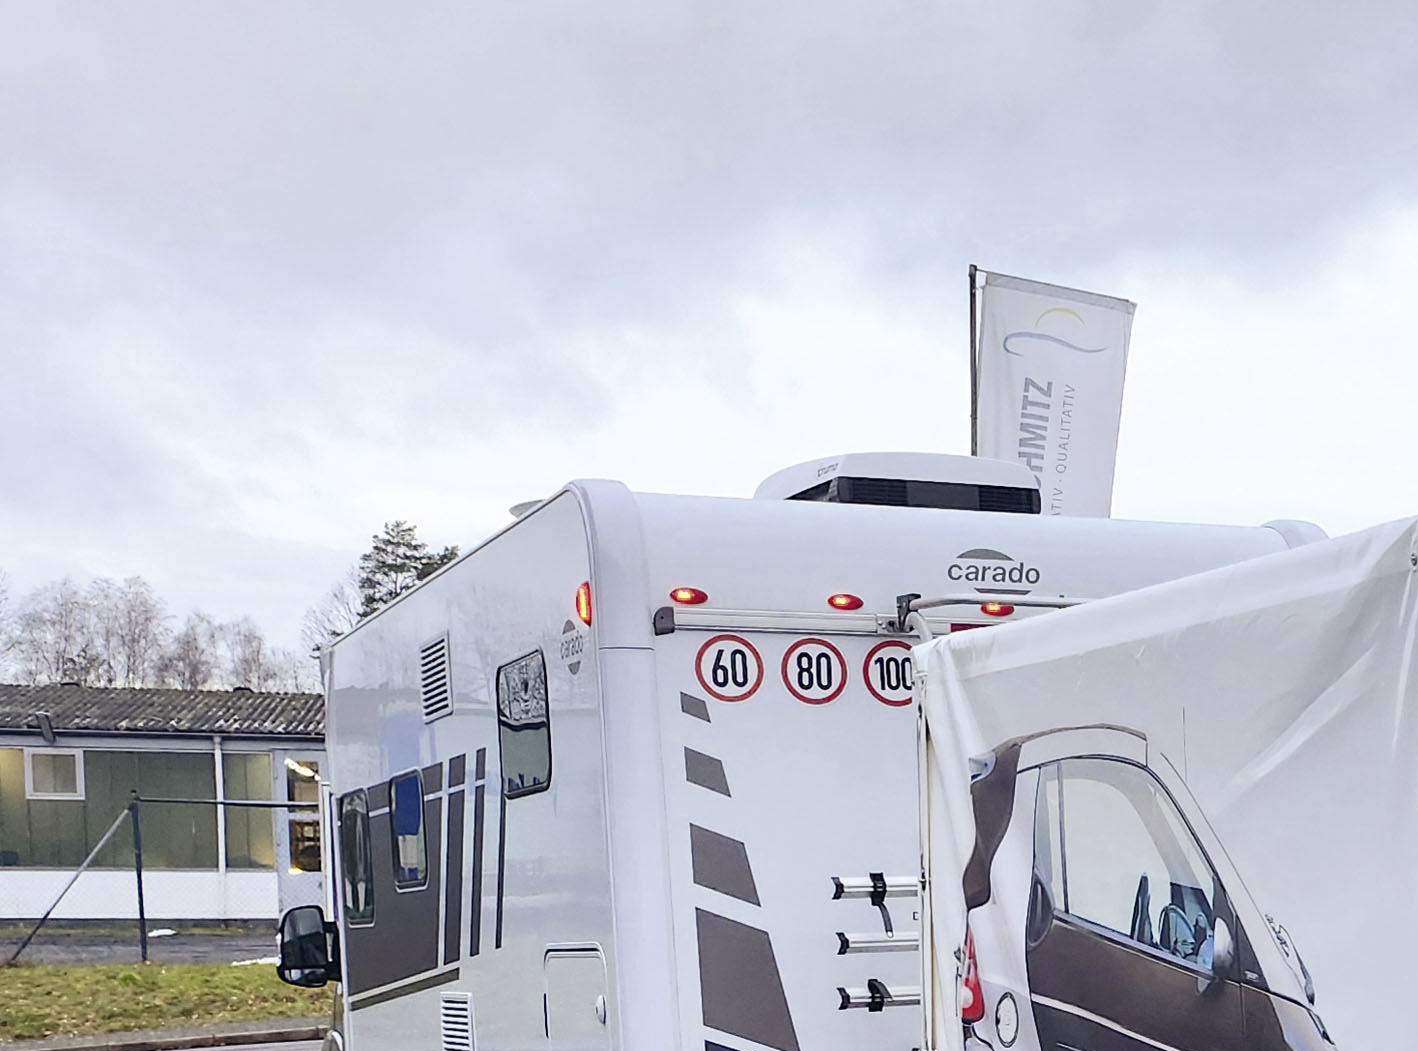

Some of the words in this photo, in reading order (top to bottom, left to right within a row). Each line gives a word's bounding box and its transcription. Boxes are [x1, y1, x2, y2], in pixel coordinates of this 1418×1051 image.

[1018, 377, 1053, 488] HMITZ
[1056, 384, 1075, 473] QUALITATIV
[947, 562, 1041, 585] carado
[711, 648, 748, 688] 60
[796, 652, 832, 691] 80
[874, 656, 912, 691] 100
